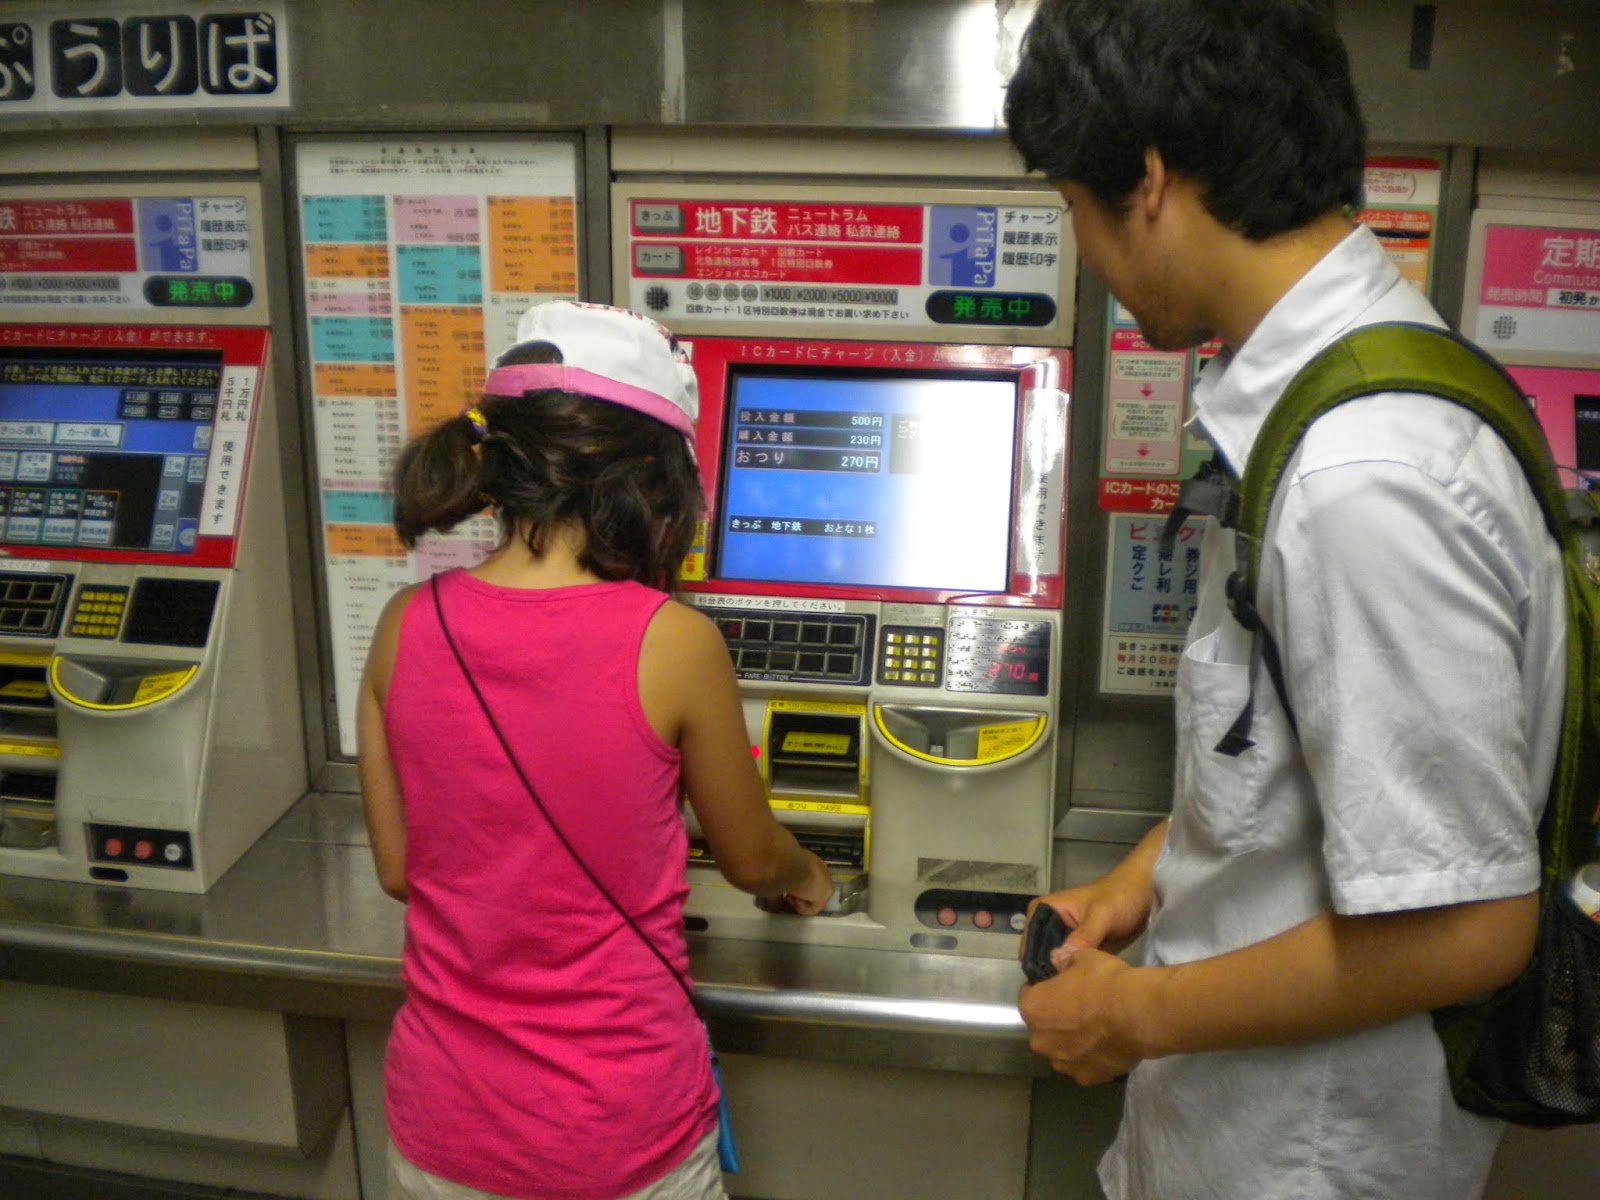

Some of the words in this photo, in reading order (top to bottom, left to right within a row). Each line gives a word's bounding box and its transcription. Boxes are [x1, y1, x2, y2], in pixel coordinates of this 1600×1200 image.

[200, 202, 246, 214] チャージ
[788, 208, 868, 221] ニュートラム
[641, 211, 674, 224] きっぷ
[695, 207, 778, 235] 地下鉄
[1004, 210, 1059, 225] チャージ
[175, 202, 193, 271] PiTaPa
[788, 224, 841, 237] バス連絡
[845, 224, 901, 239] 私鉄連絡
[1002, 231, 1058, 246] 履歴表示
[973, 211, 995, 285] PiTaPa
[641, 252, 673, 265] カード
[1001, 252, 1057, 267] 履歴印字
[168, 280, 236, 303] 発売中
[764, 287, 791, 300] ¥1000
[797, 288, 827, 301] ¥2000
[831, 289, 862, 302] ¥5000
[953, 295, 1031, 321] 発売中
[851, 415, 884, 429] 500円
[849, 434, 882, 448] 230円
[736, 449, 786, 466] おつり
[841, 454, 879, 472] 270円
[211, 440, 235, 526] 使用できます
[731, 519, 762, 532] きっぷ
[771, 520, 803, 533] 地下鉄
[823, 522, 876, 537] おとな1枚
[698, 596, 842, 611] 料金表のボタンを押してください。
[988, 661, 1026, 680] 270
[816, 803, 842, 811] CHANGE
